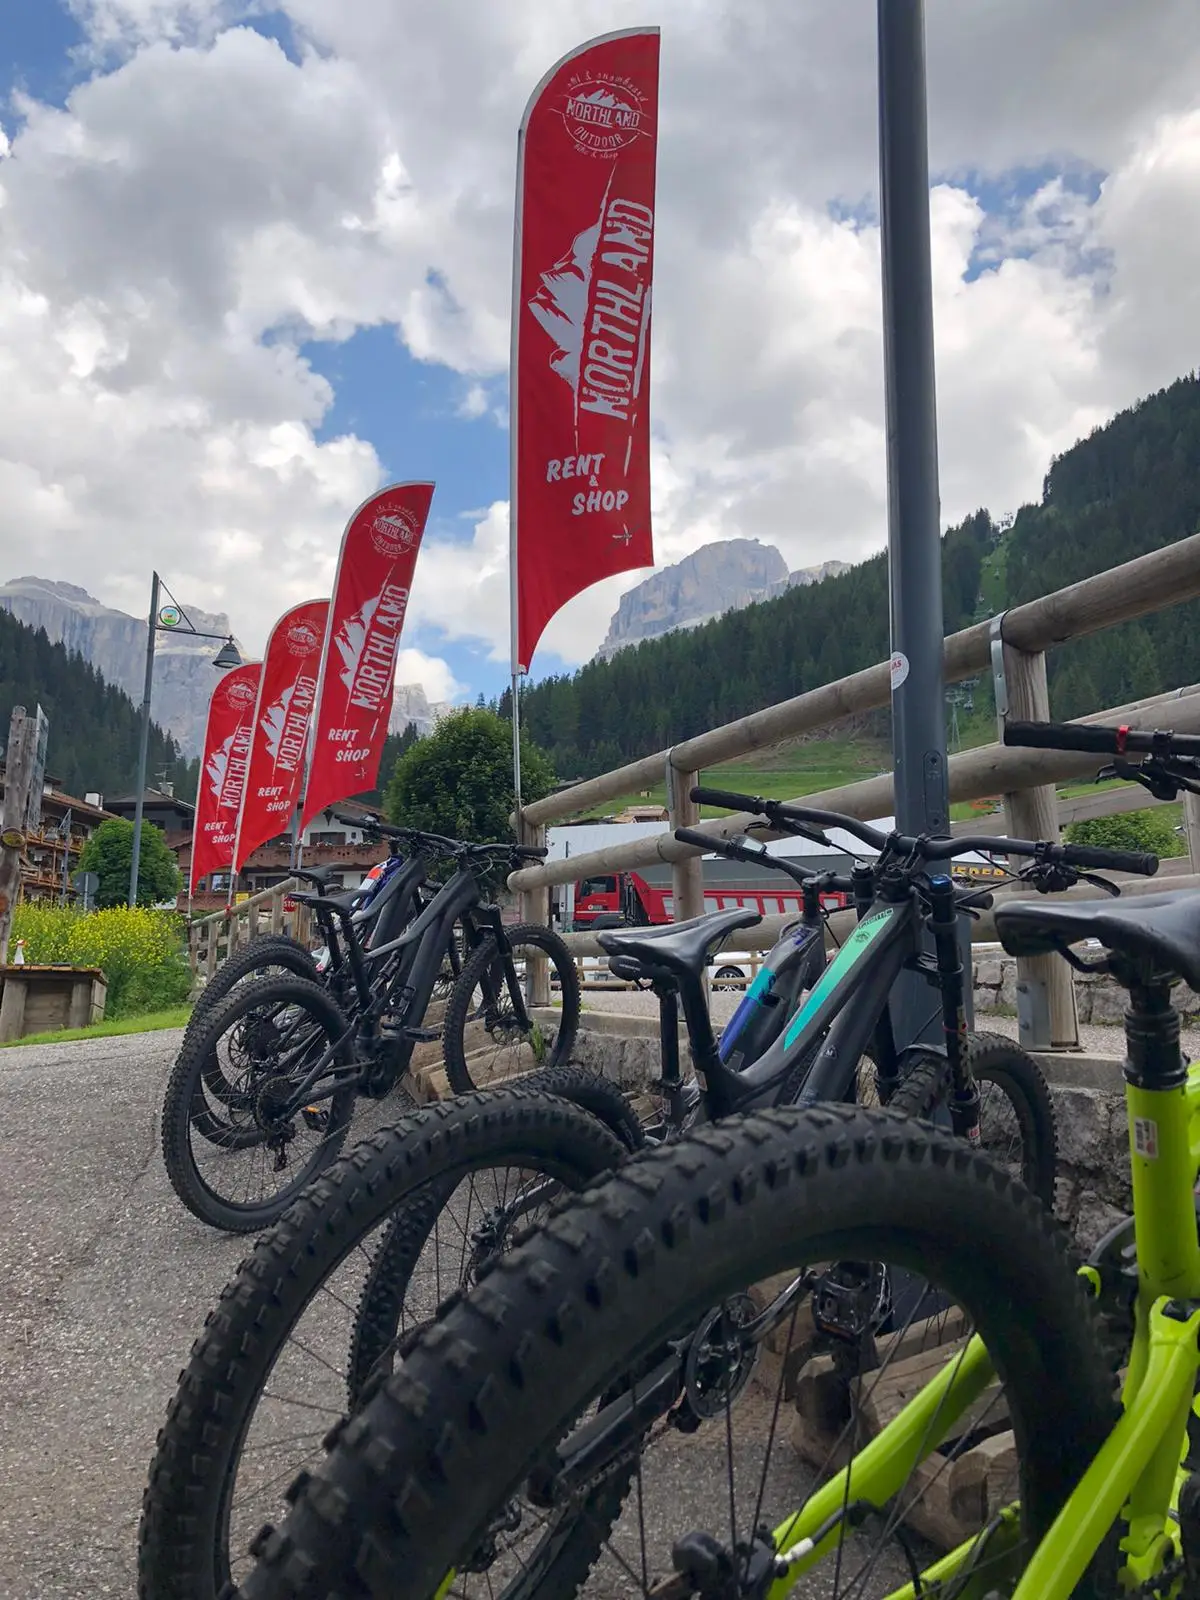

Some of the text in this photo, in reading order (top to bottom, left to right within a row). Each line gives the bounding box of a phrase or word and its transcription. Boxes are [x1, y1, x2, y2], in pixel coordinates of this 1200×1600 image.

[566, 98, 641, 128] NORTHLAND
[574, 126, 623, 147] OUTDOOR
[580, 198, 653, 421] NORTHLAND
[546, 453, 606, 482] RENT
[588, 474, 599, 487] &
[571, 489, 629, 515] SHOP
[350, 584, 409, 711] NORTHLAND
[277, 676, 317, 772] NORTHLAND
[328, 728, 360, 741] RENT
[335, 748, 371, 762] SHOP
[257, 786, 284, 797] RENT
[266, 800, 291, 812] SHOP
[204, 821, 228, 831] RENT
[212, 833, 236, 844] SHOP
